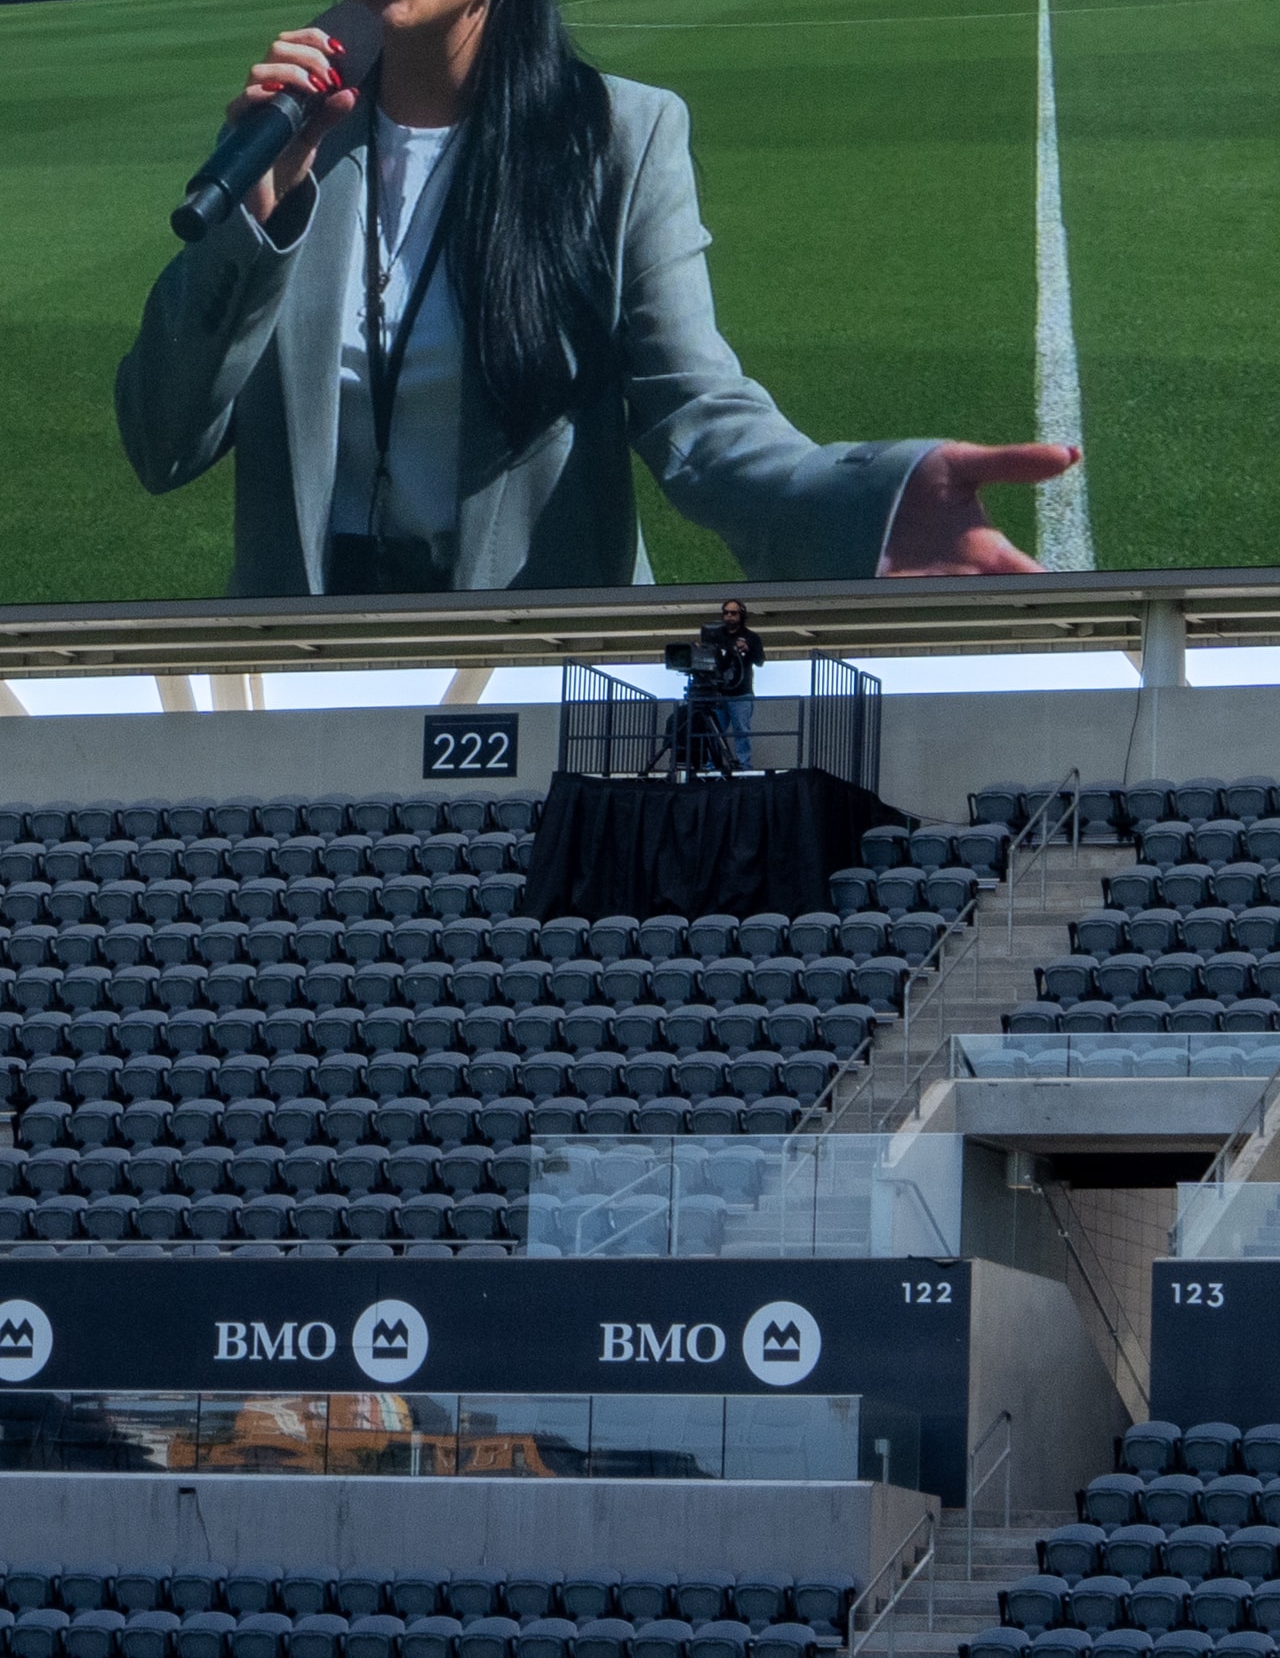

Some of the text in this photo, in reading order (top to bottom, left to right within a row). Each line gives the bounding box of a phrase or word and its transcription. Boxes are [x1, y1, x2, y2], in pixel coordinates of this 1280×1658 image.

[432, 732, 508, 769] 222
[902, 1282, 951, 1302] 122
[1172, 1283, 1223, 1307] 123
[214, 1322, 336, 1360] BMO
[599, 1324, 725, 1362] BMO
